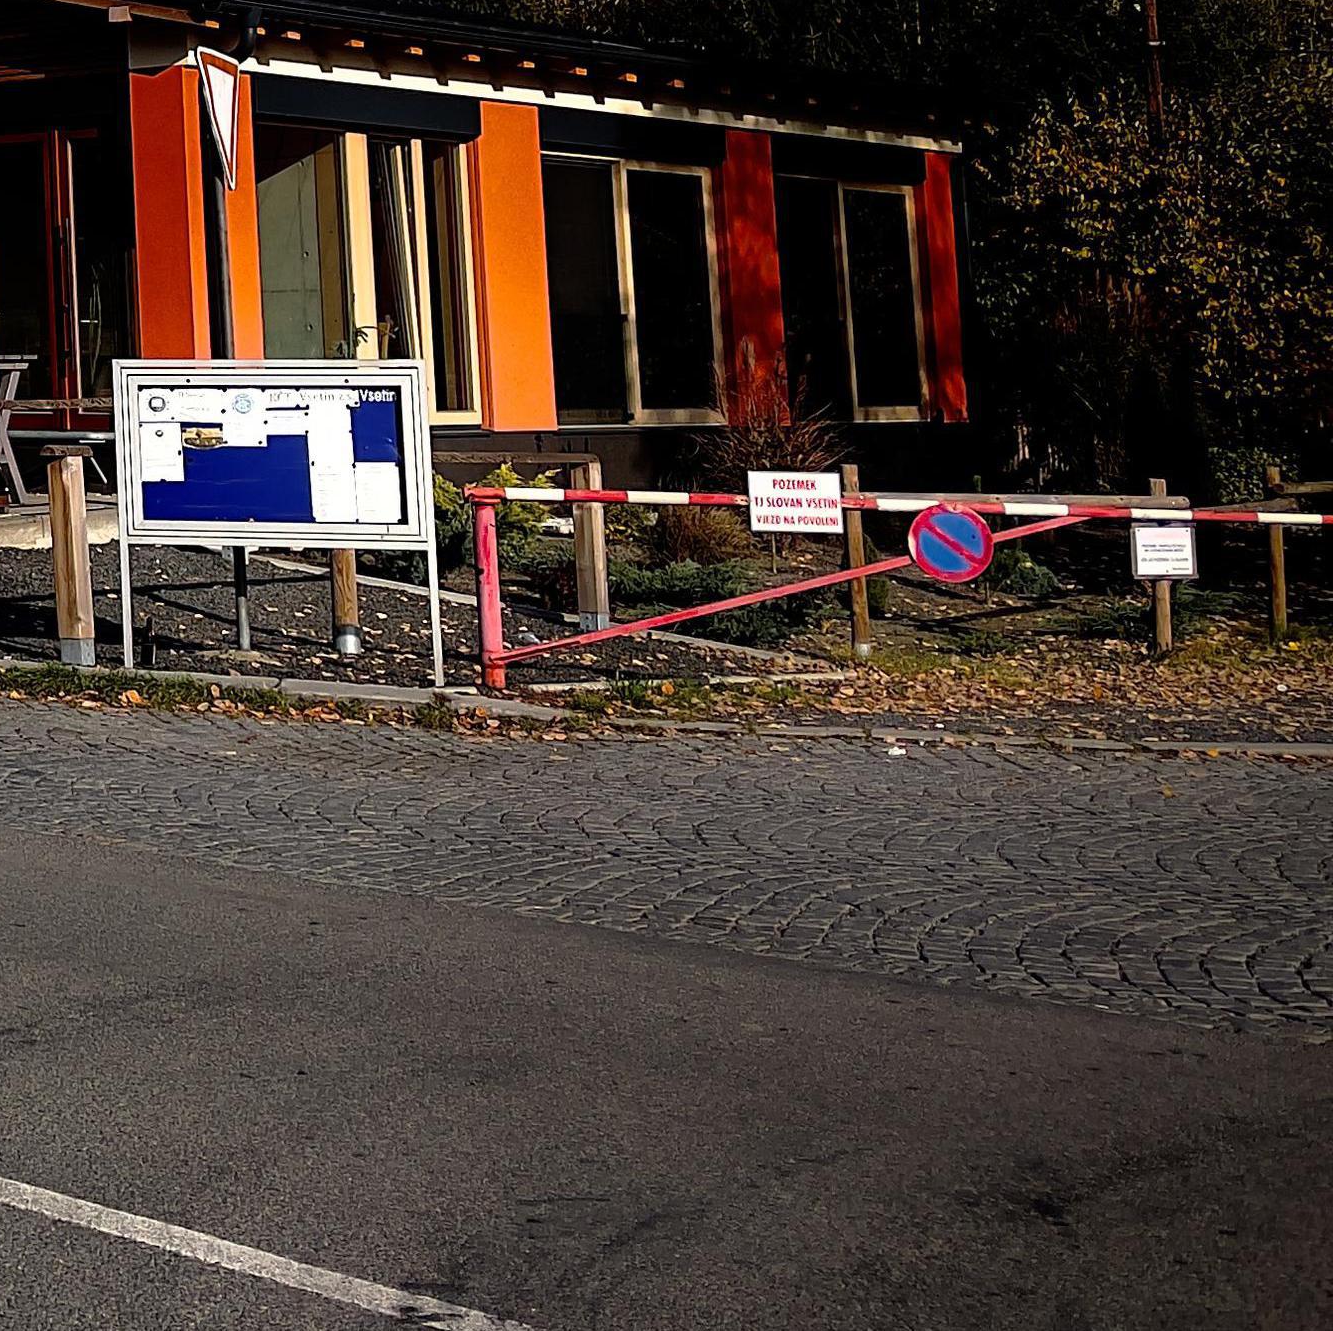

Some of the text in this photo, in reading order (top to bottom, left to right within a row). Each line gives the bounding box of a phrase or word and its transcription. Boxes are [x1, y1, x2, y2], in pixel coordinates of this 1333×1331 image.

[772, 479, 817, 490] POZEMEK
[754, 496, 764, 507] TJ
[766, 496, 803, 508] SLOVAN
[756, 514, 781, 525] VJEZD
[783, 516, 796, 525] NA
